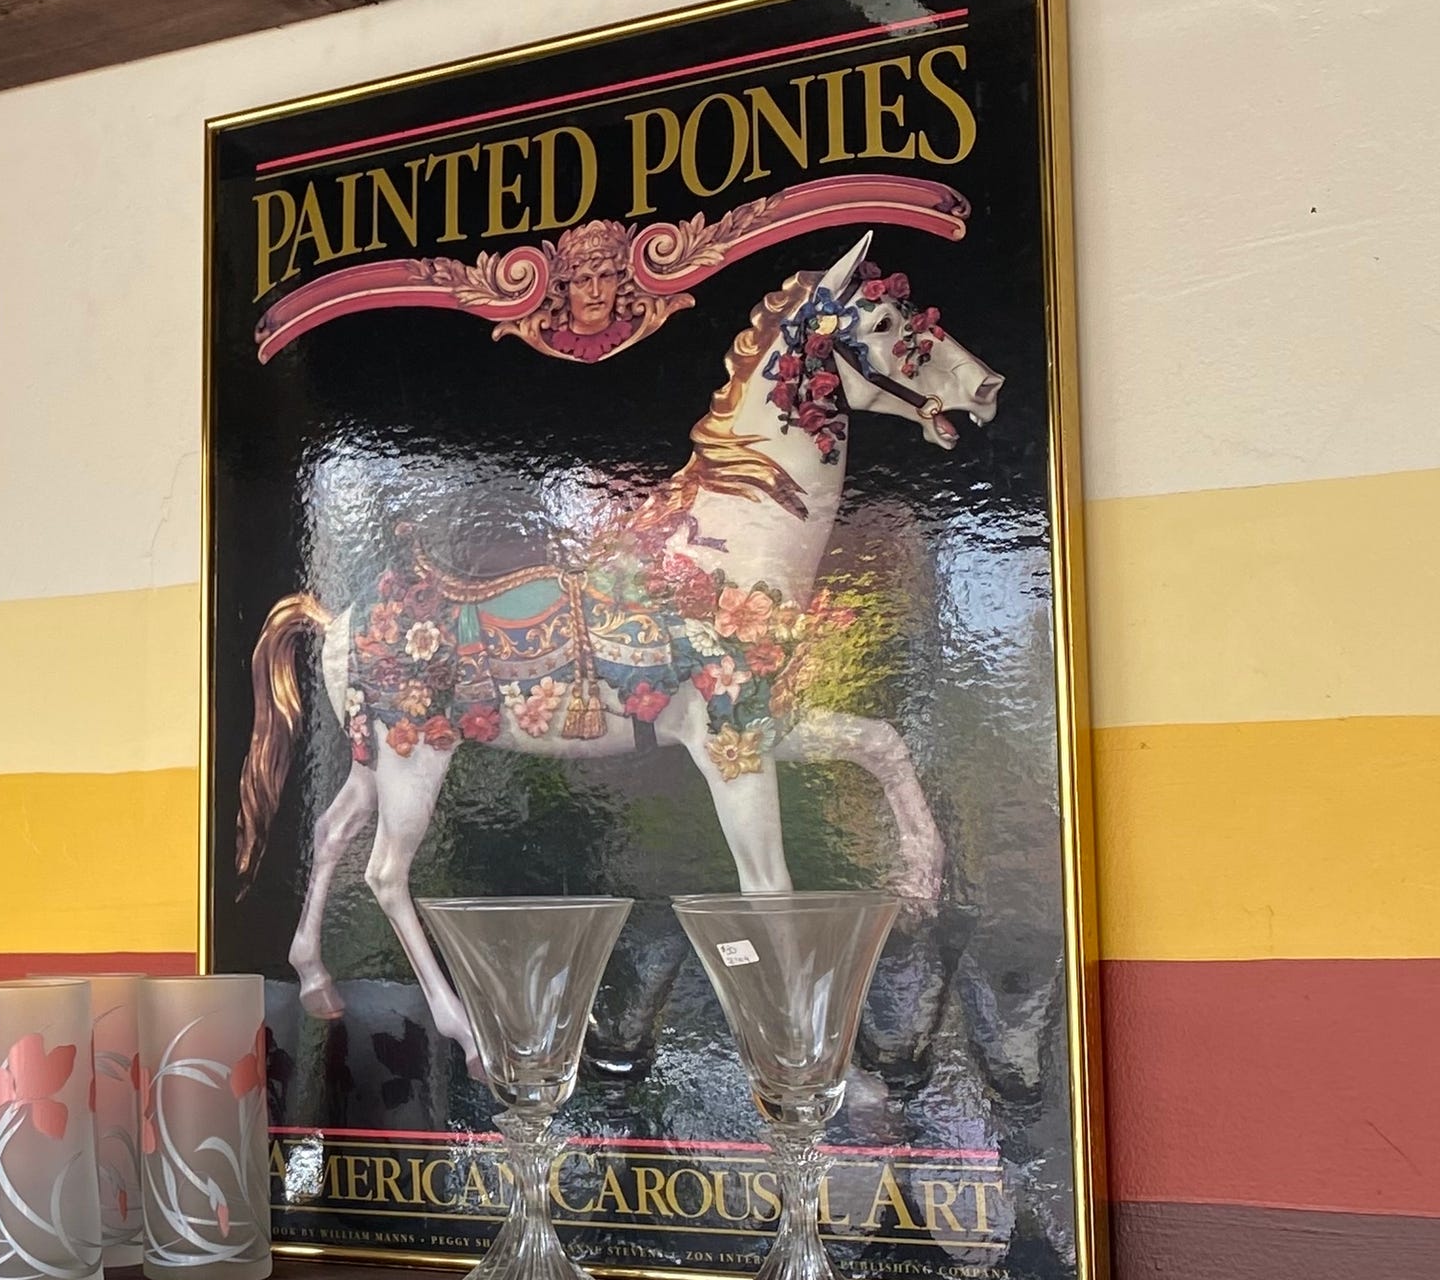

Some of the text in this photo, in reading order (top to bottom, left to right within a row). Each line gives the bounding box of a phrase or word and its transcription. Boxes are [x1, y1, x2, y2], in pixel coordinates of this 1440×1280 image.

[252, 44, 978, 304] PAINTED PONIES
[548, 1150, 850, 1225] CAROUSL
[860, 1163, 1003, 1233] ART
[272, 1226, 296, 1236] OOK
[320, 1228, 371, 1241] WILLIAM
[374, 1232, 415, 1244] MANNS
[431, 1234, 470, 1247] PEGGY
[685, 1250, 713, 1263] ZON
[839, 1259, 933, 1275] PUBLISHING
[938, 1264, 1011, 1280] COMPANY
